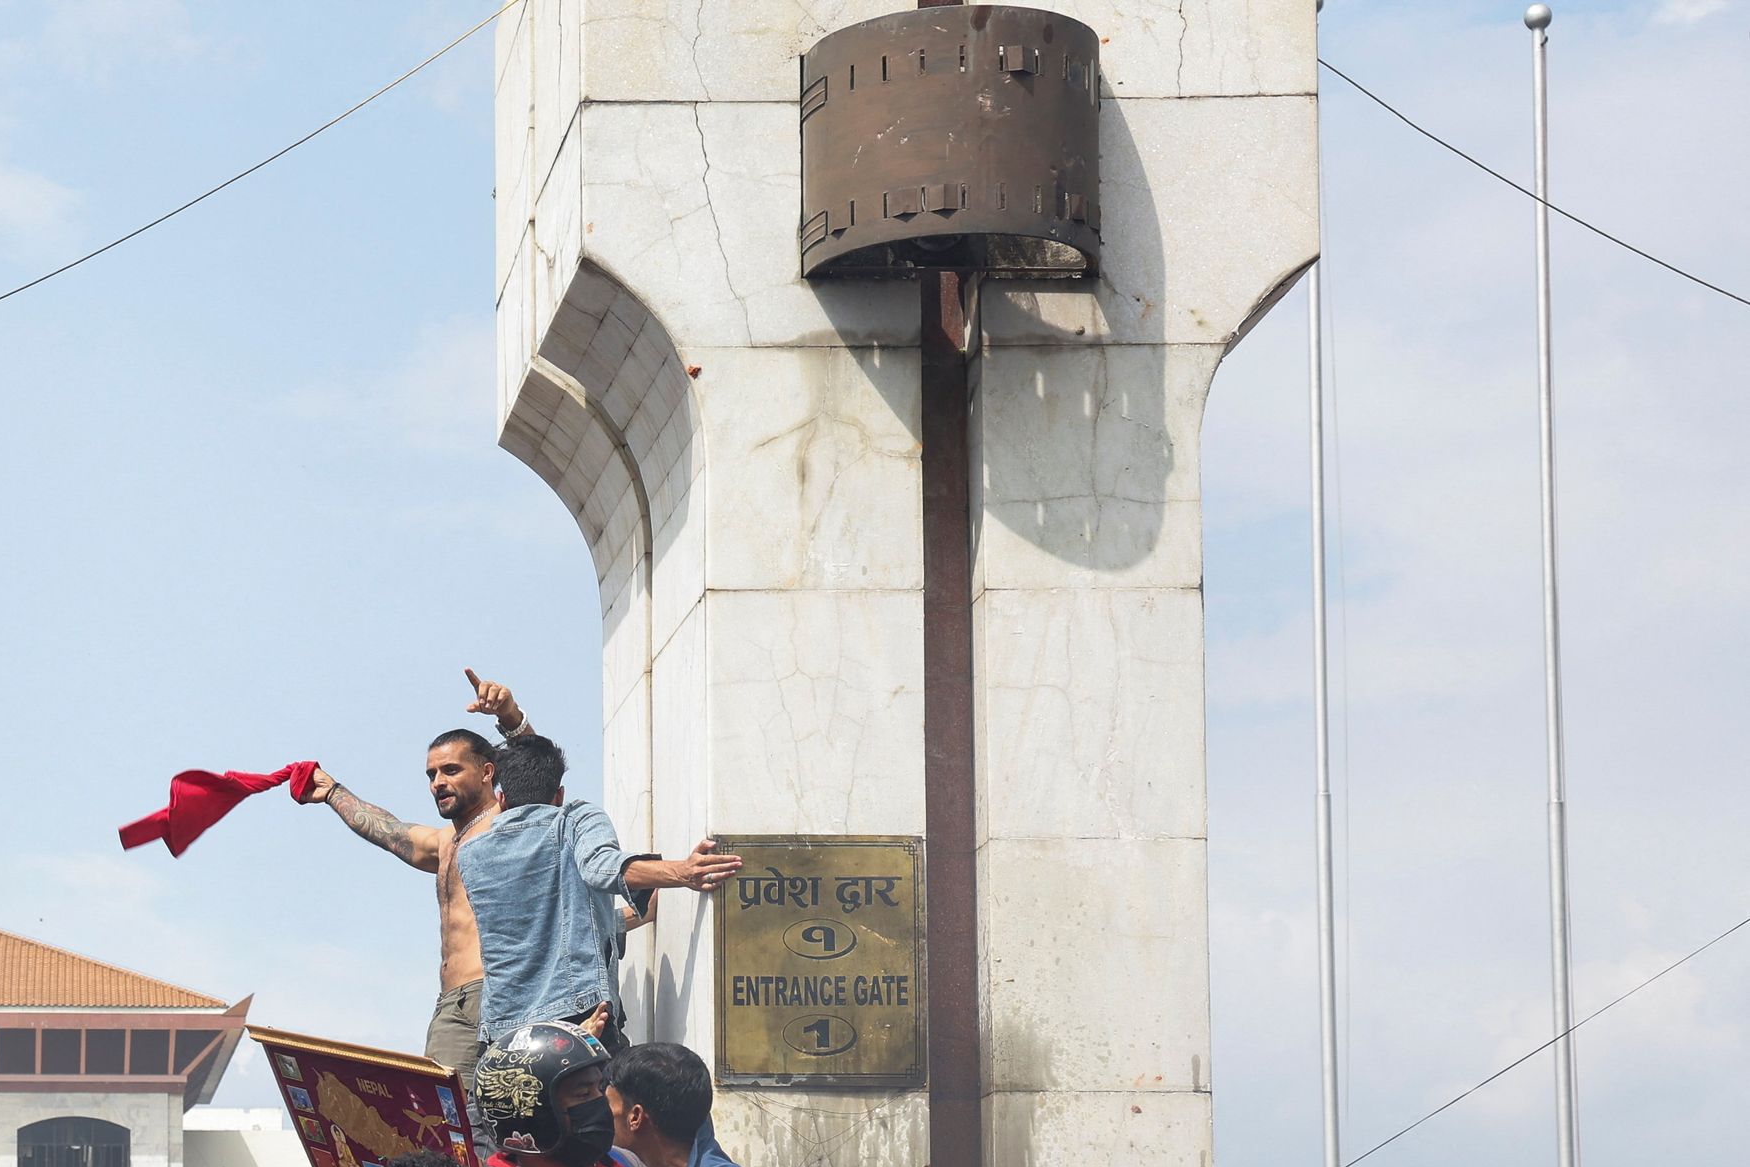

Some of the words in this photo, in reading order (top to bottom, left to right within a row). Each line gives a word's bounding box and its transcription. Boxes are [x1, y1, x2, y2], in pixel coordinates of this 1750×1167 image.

[737, 867, 822, 910] प्रवेश
[835, 876, 903, 913] द्वार
[732, 975, 847, 1006] ENTRANCE
[853, 975, 909, 1006] GATE
[802, 1018, 830, 1048] 1
[355, 1077, 394, 1099] NEPAL
